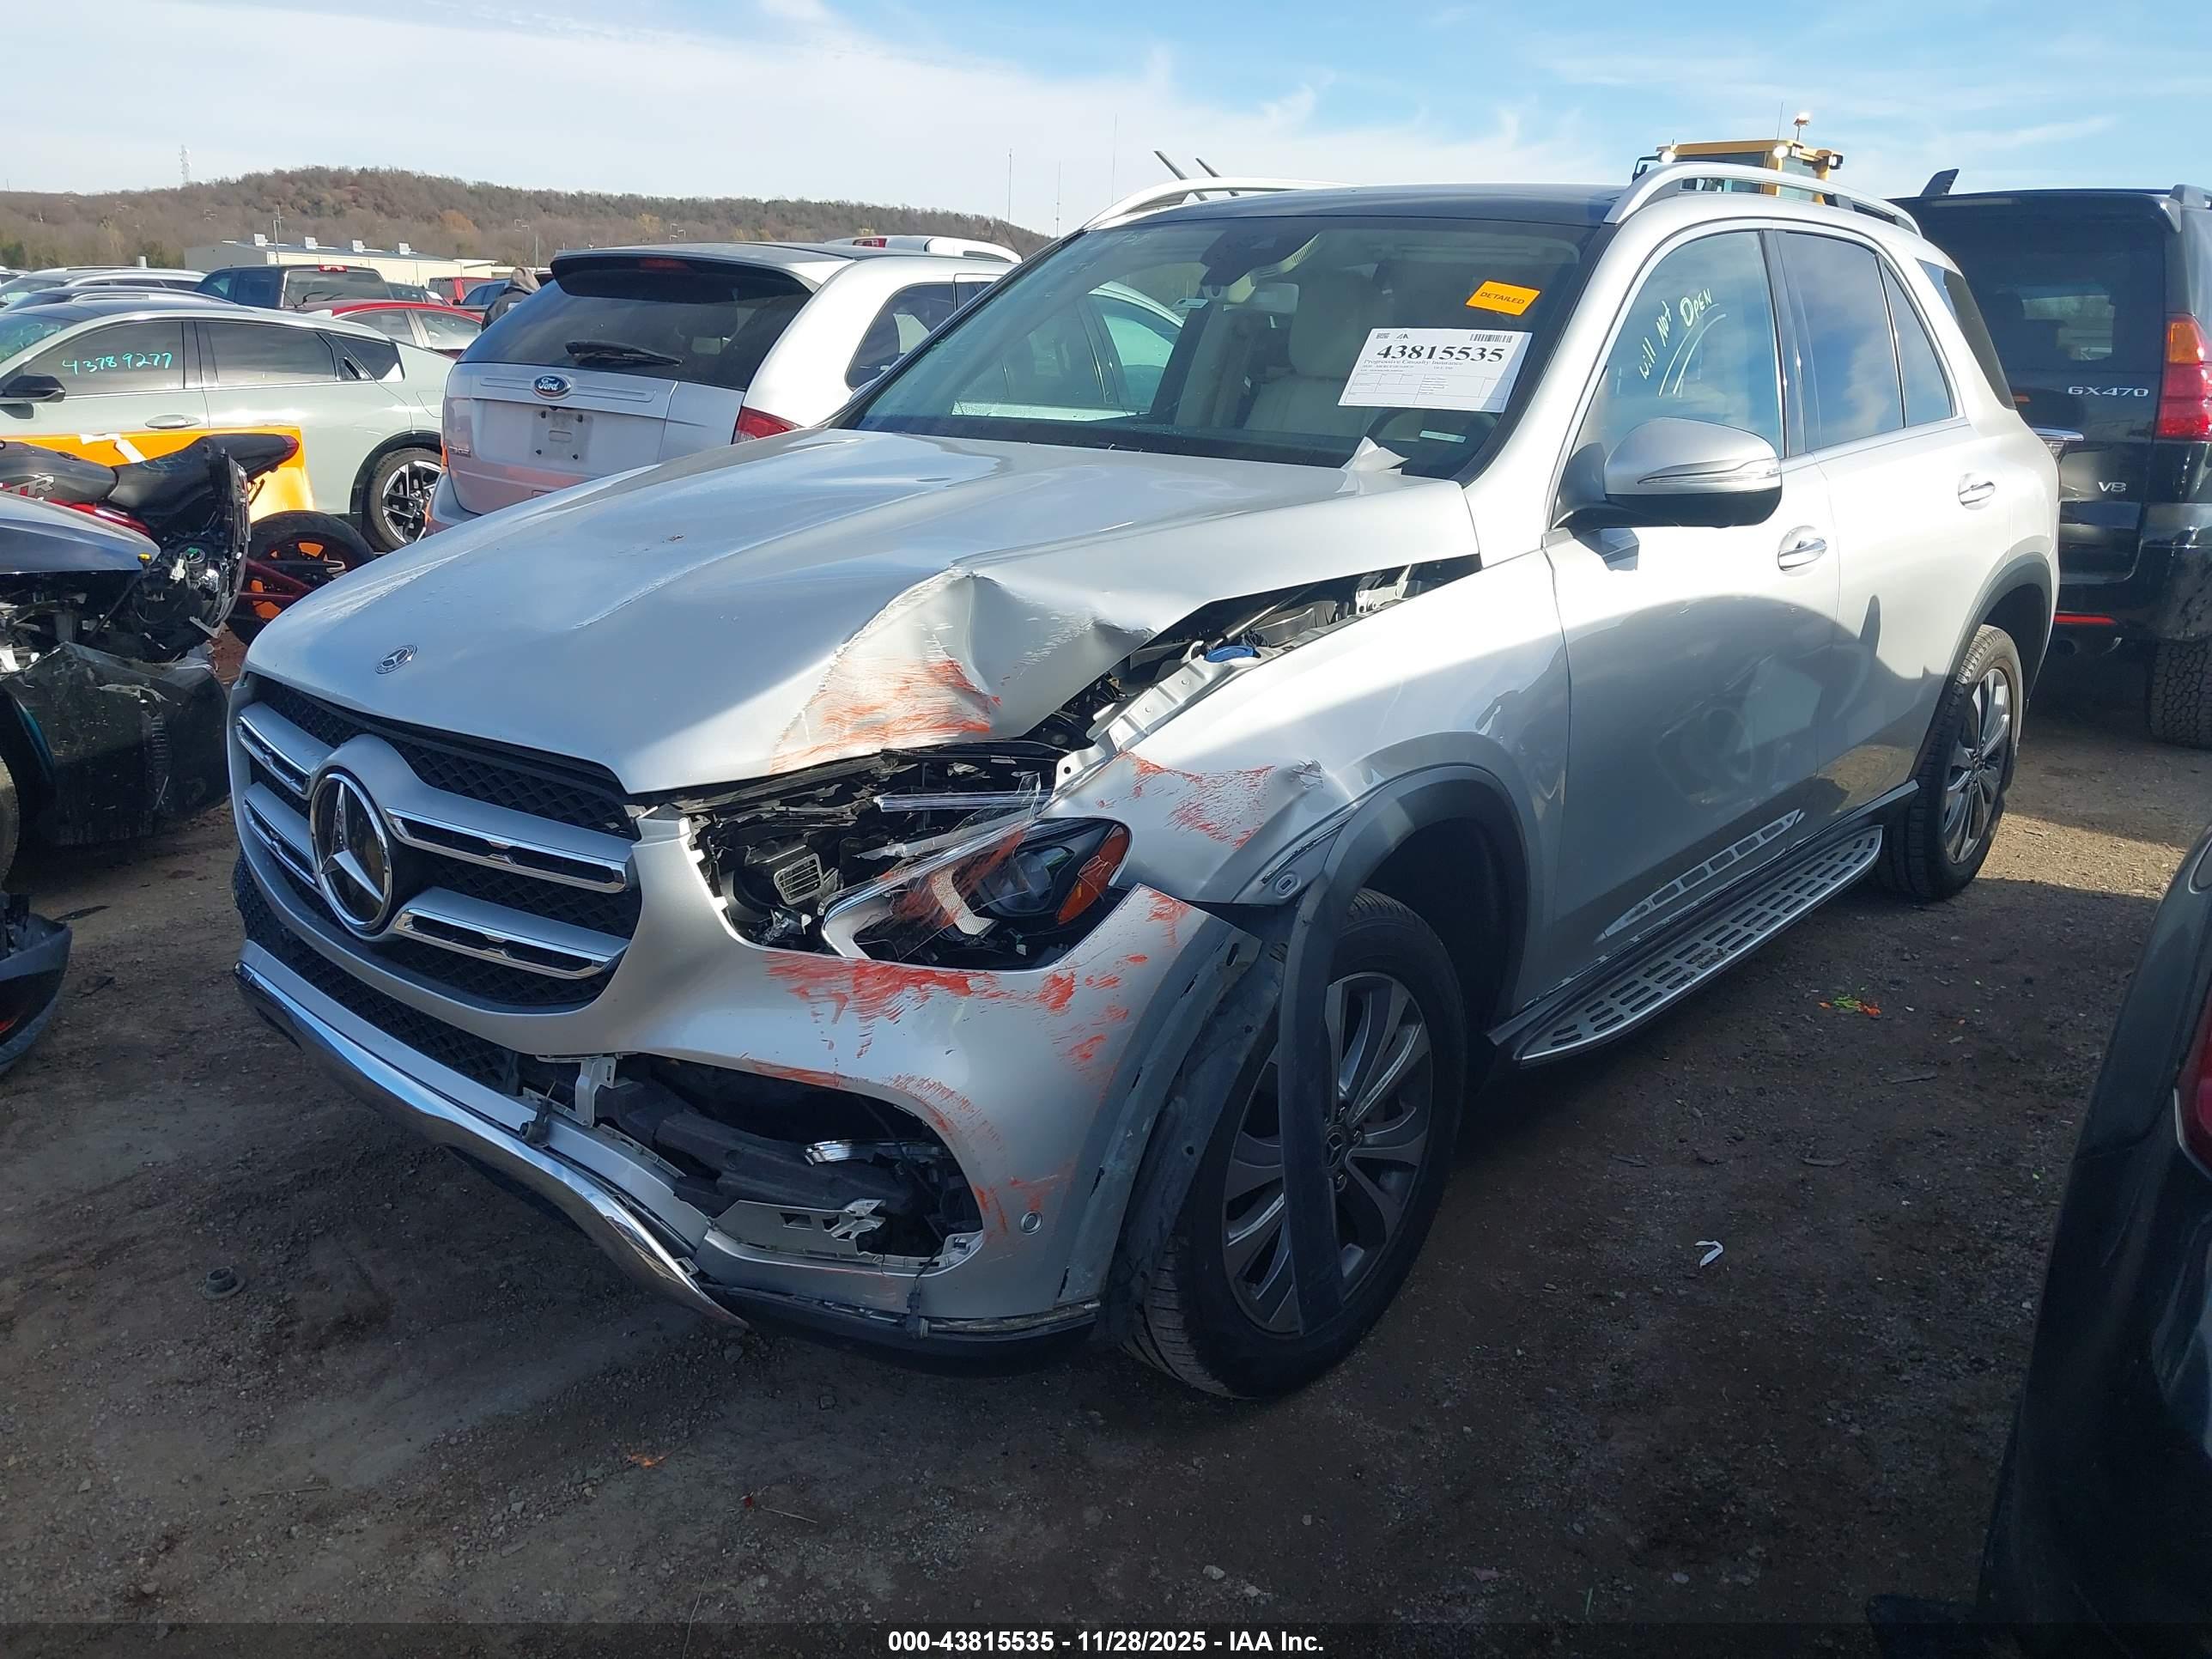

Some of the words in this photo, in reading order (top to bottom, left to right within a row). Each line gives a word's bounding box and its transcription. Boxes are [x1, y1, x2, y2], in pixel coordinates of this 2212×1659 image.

[1480, 291, 1525, 305] DETAILED
[1376, 344, 1505, 362] 43815535
[538, 377, 559, 392] Ford
[2068, 386, 2148, 397] GX470
[2098, 481, 2127, 492] V8
